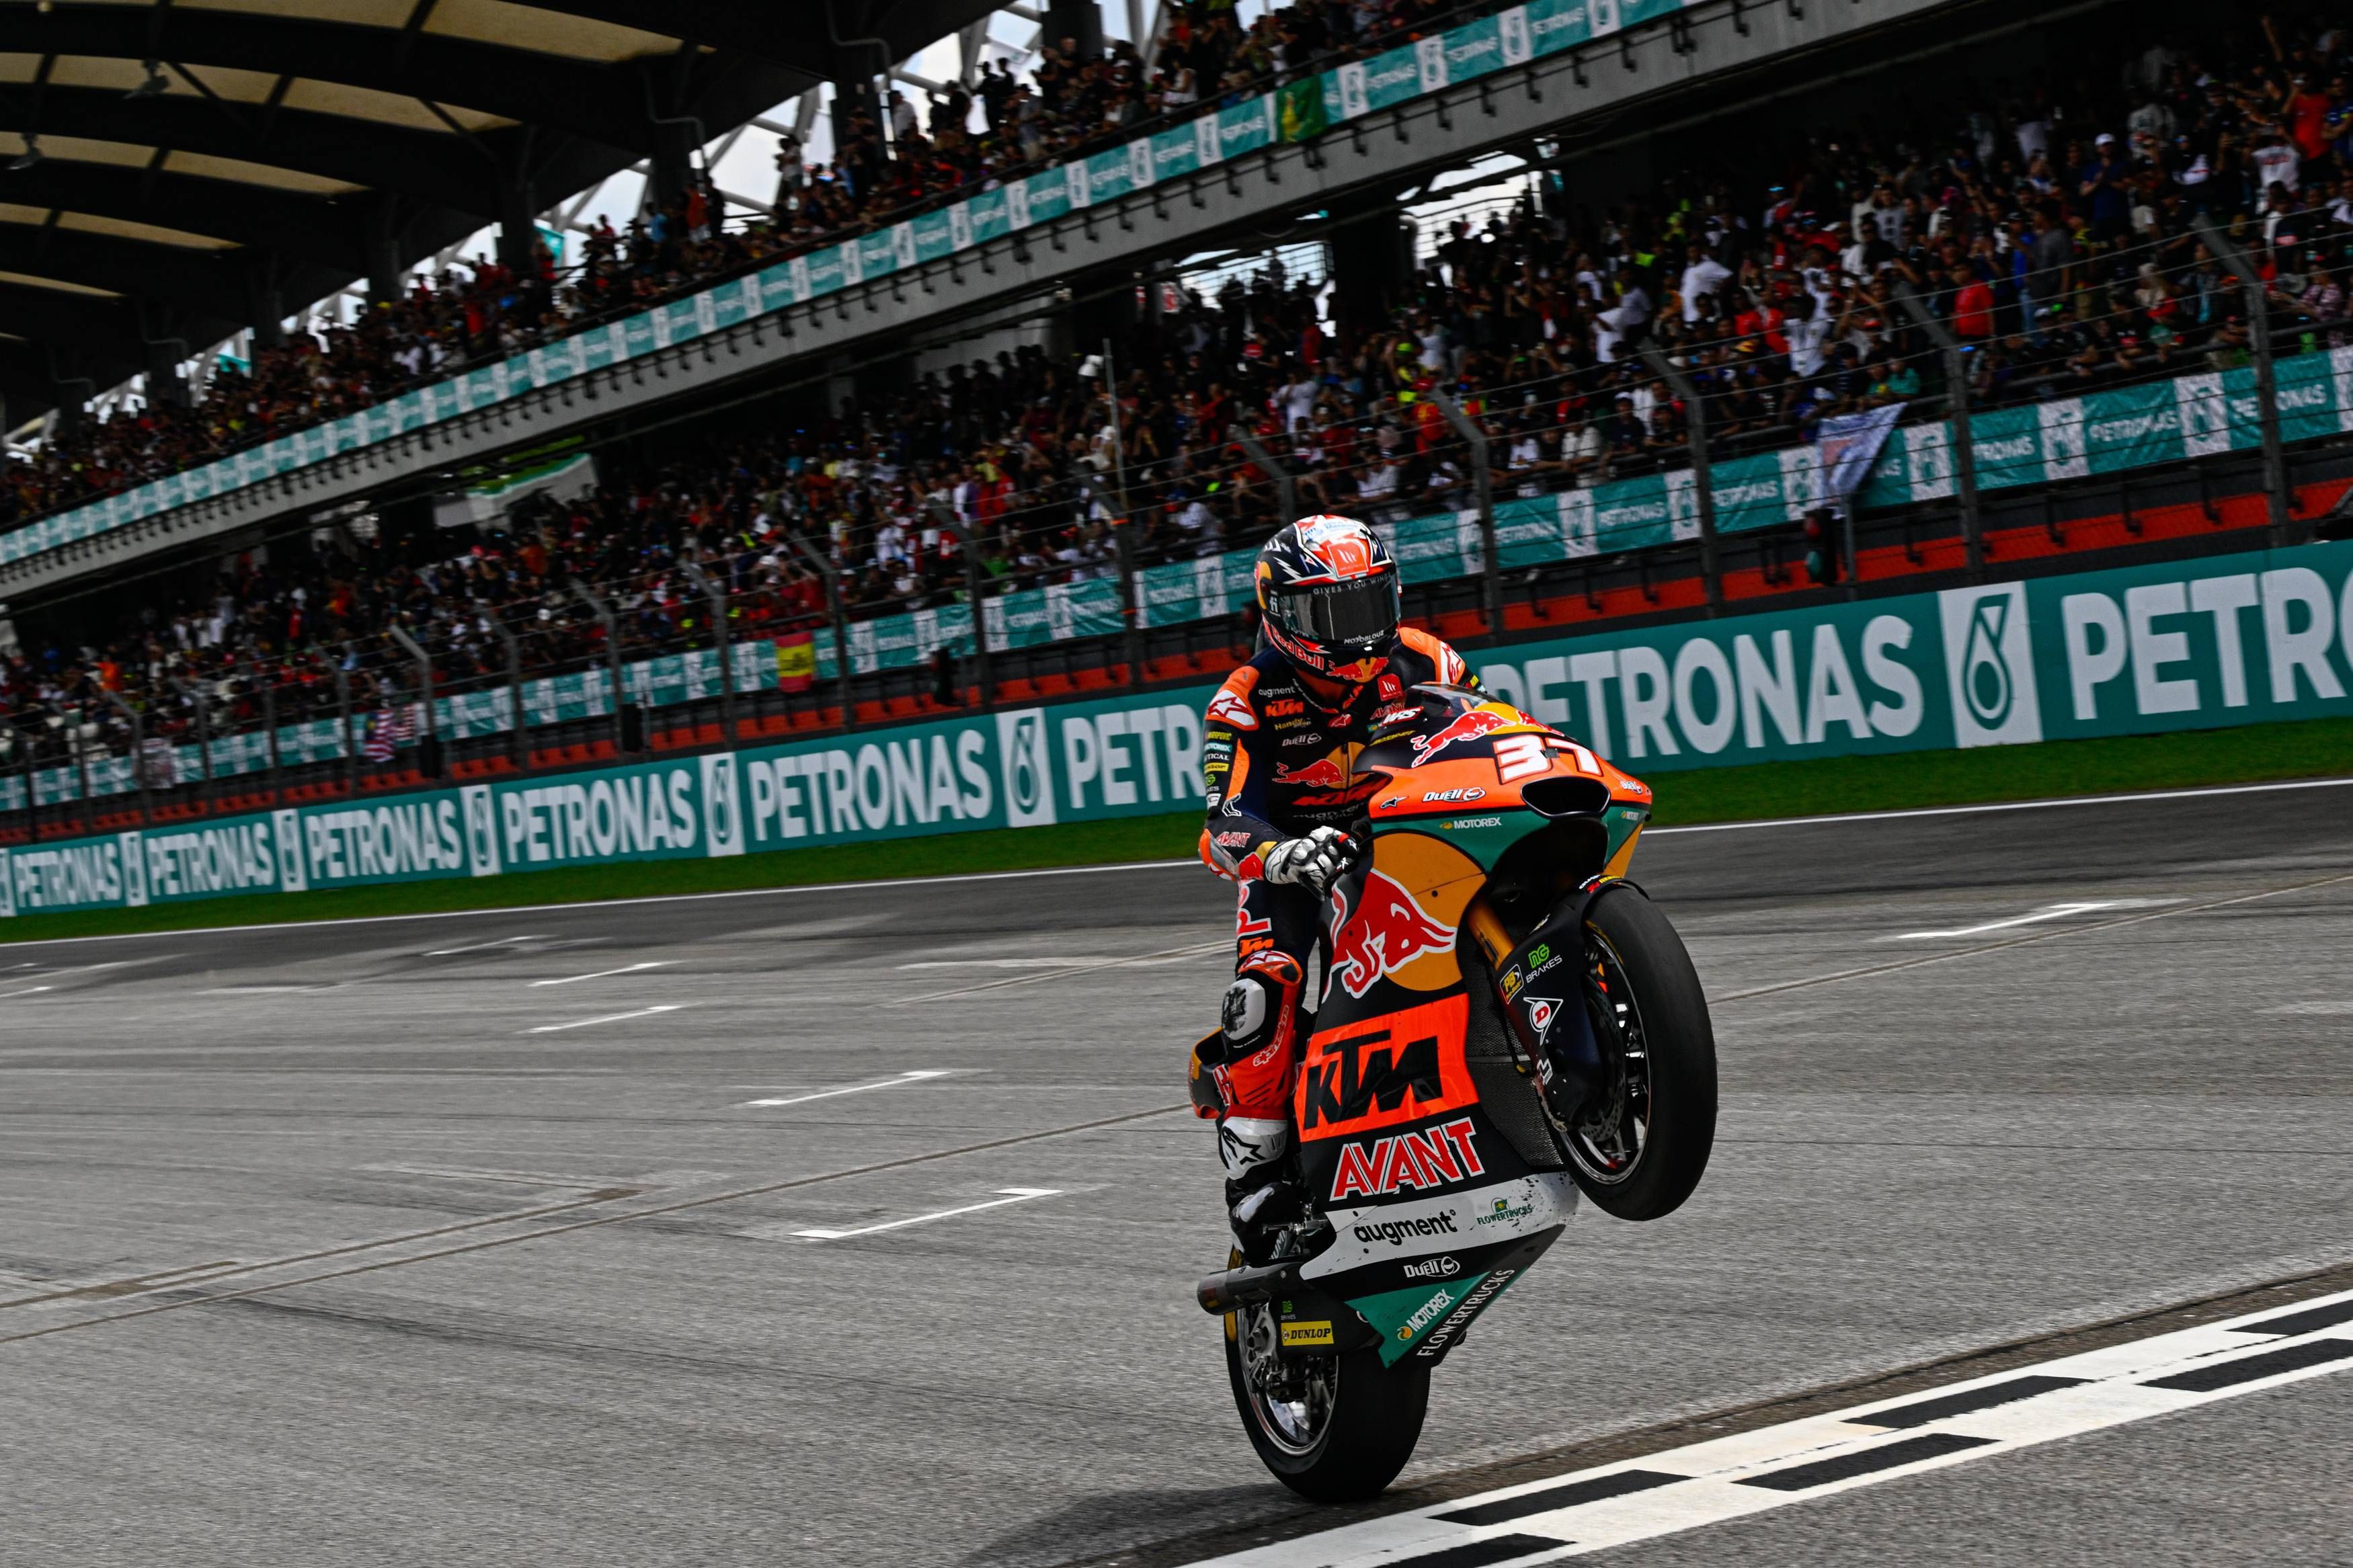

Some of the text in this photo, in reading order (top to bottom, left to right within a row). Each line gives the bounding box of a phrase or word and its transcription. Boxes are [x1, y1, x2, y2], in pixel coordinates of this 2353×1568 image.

[1313, 584, 1342, 595] GIVES
[1347, 581, 1367, 591] YOU
[1271, 624, 1294, 655] Red
[1295, 647, 1324, 671] Bull
[1259, 686, 1295, 697] augment
[1265, 699, 1304, 717] KTM
[1062, 704, 1207, 809] PETR
[1493, 734, 1603, 784] 37
[748, 730, 992, 841] PETRONAS
[305, 798, 463, 881] PETRONAS
[502, 769, 696, 864] PETRONAS
[1215, 831, 1251, 848] AVANT
[1453, 817, 1502, 829] MOTOREX
[13, 842, 122, 908] PETRONAS
[146, 822, 276, 897] PETRONAS
[1525, 954, 1563, 983] BRAKES
[1304, 1030, 1443, 1130] KTM
[1329, 1116, 1486, 1202] AVANT
[1354, 1211, 1458, 1246] augment
[1476, 1204, 1533, 1225] FLOWERTRUCKS
[1291, 1328, 1331, 1339] DUNLOP
[1406, 1288, 1455, 1332] MOTOREX
[1417, 1270, 1515, 1356] FLOWERTRUCKS
